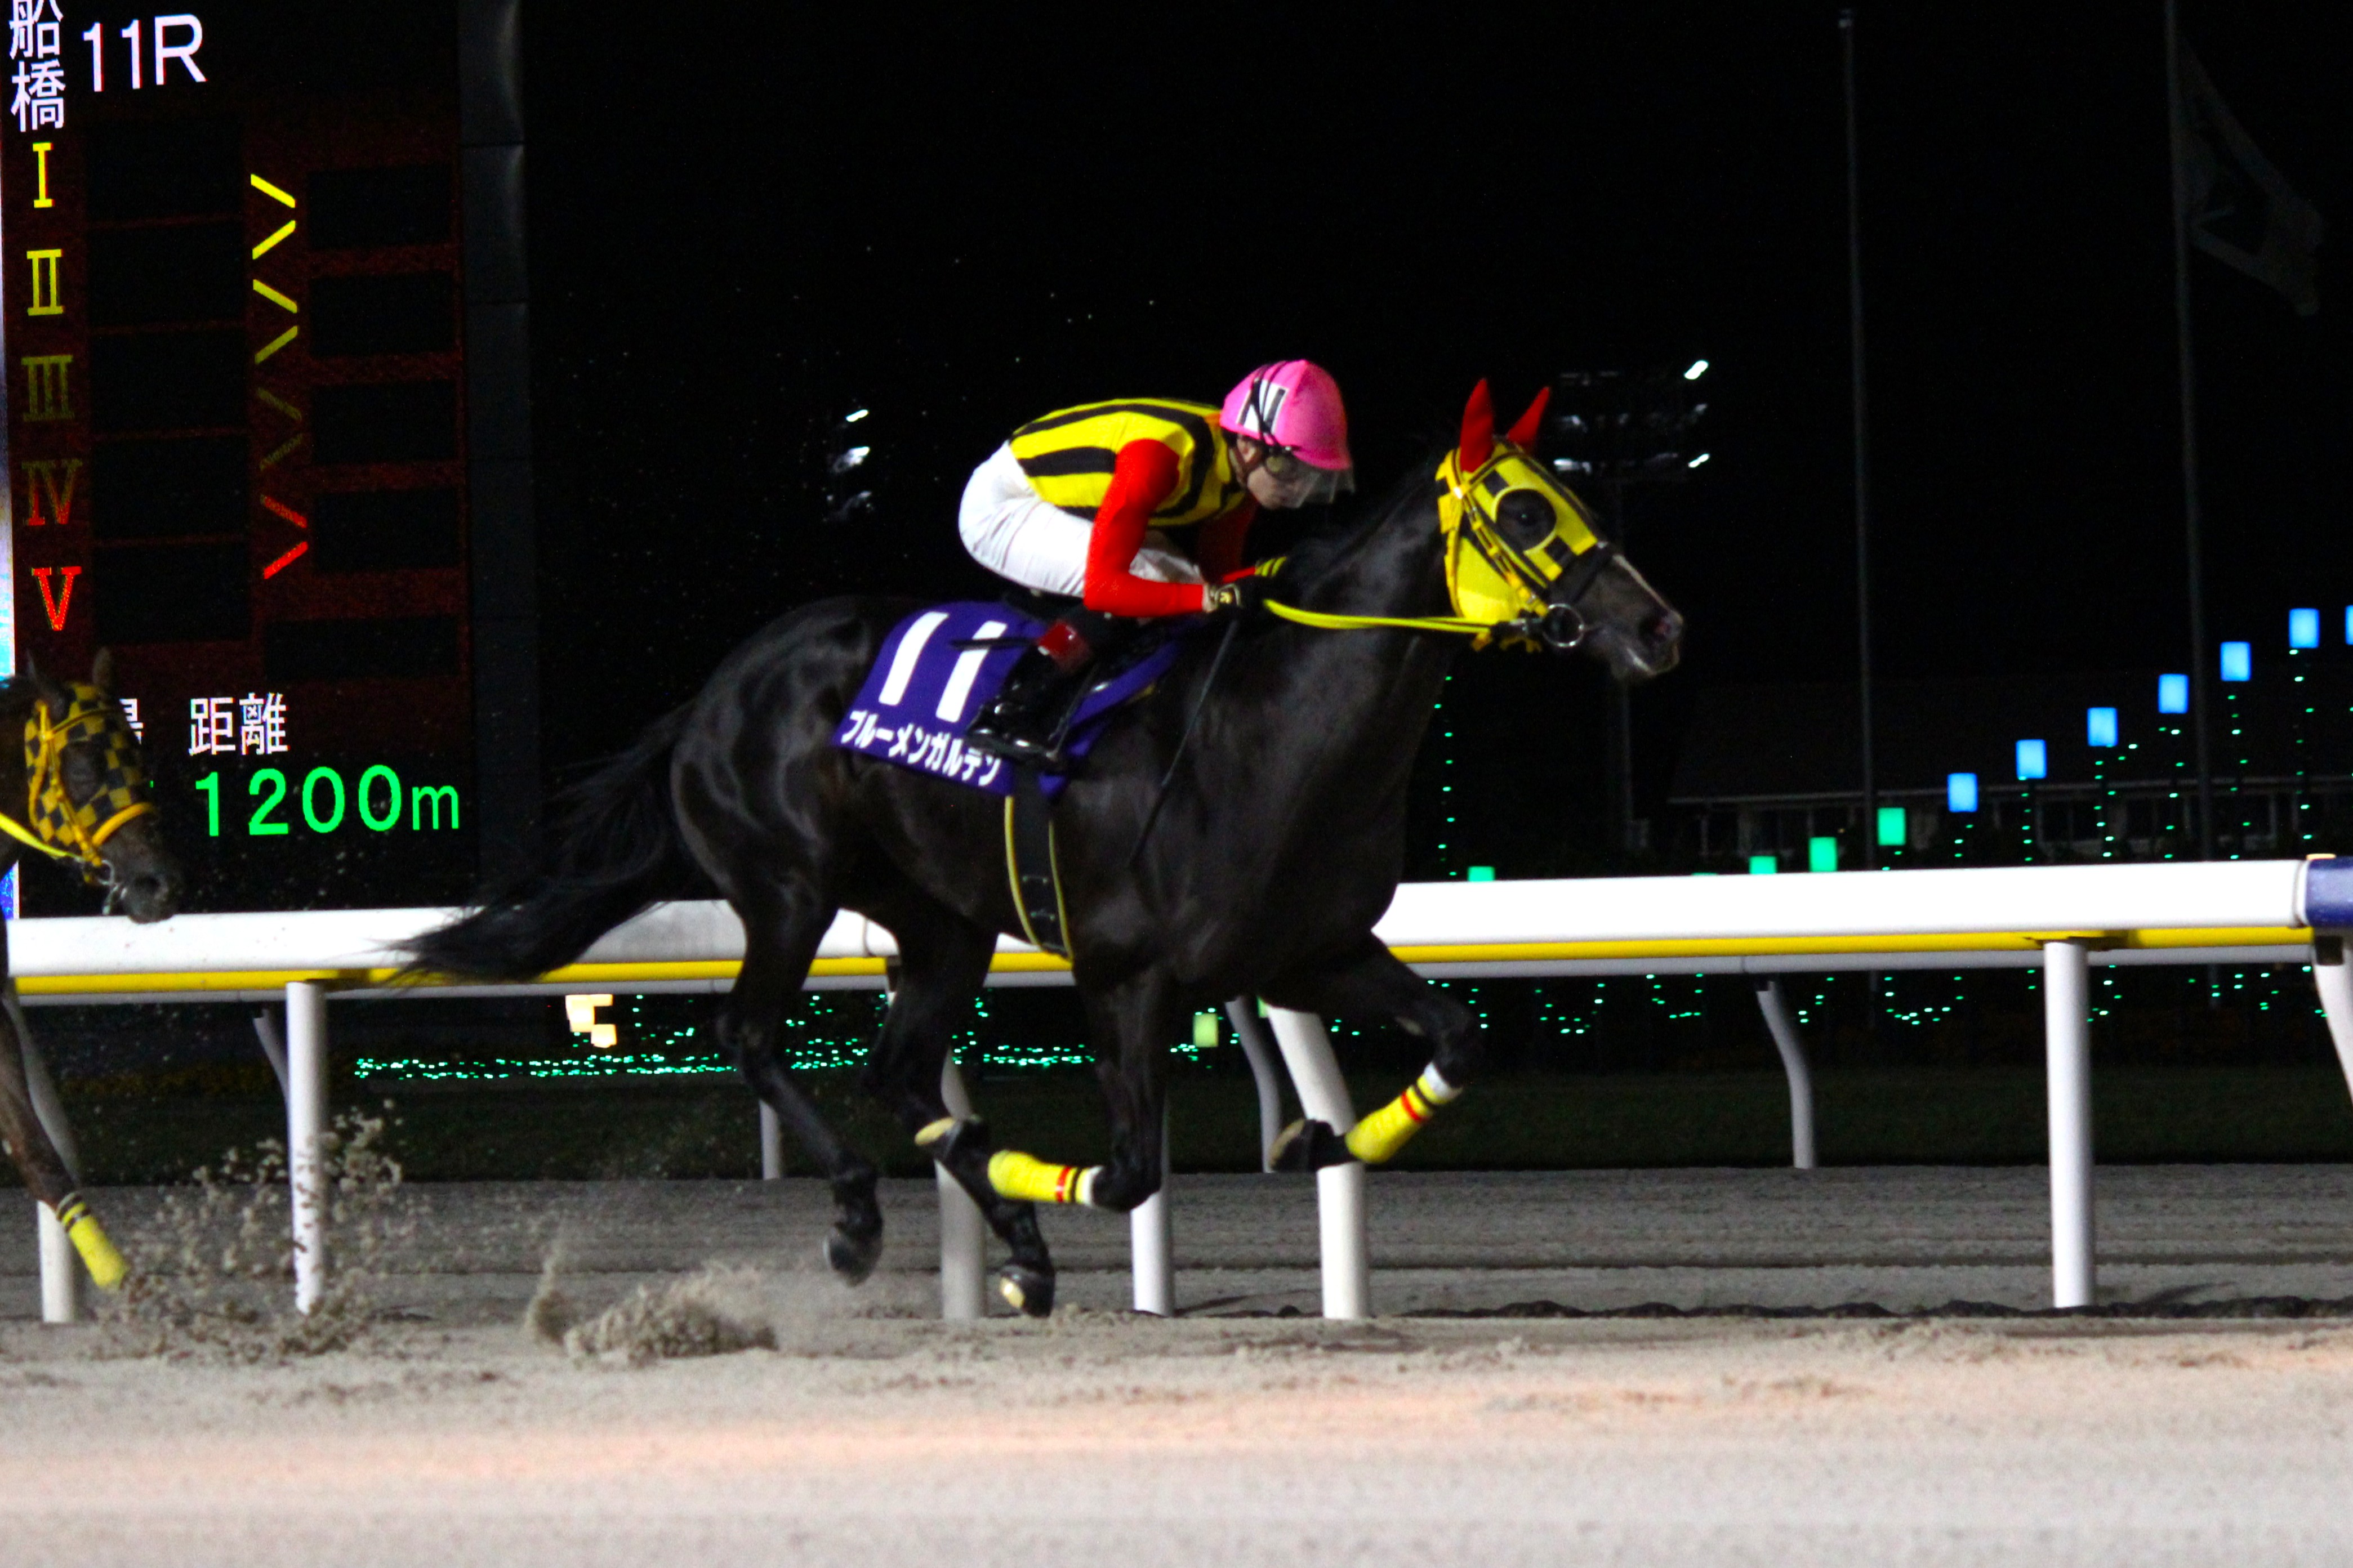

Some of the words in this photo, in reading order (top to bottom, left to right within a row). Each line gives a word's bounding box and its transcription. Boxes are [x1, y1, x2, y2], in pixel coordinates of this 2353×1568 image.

[8, 0, 66, 132] 船橋
[82, 14, 207, 92] 11R
[32, 566, 82, 631] V
[879, 611, 1008, 722] 11
[188, 692, 290, 756] 距離
[195, 765, 459, 837] 1200m
